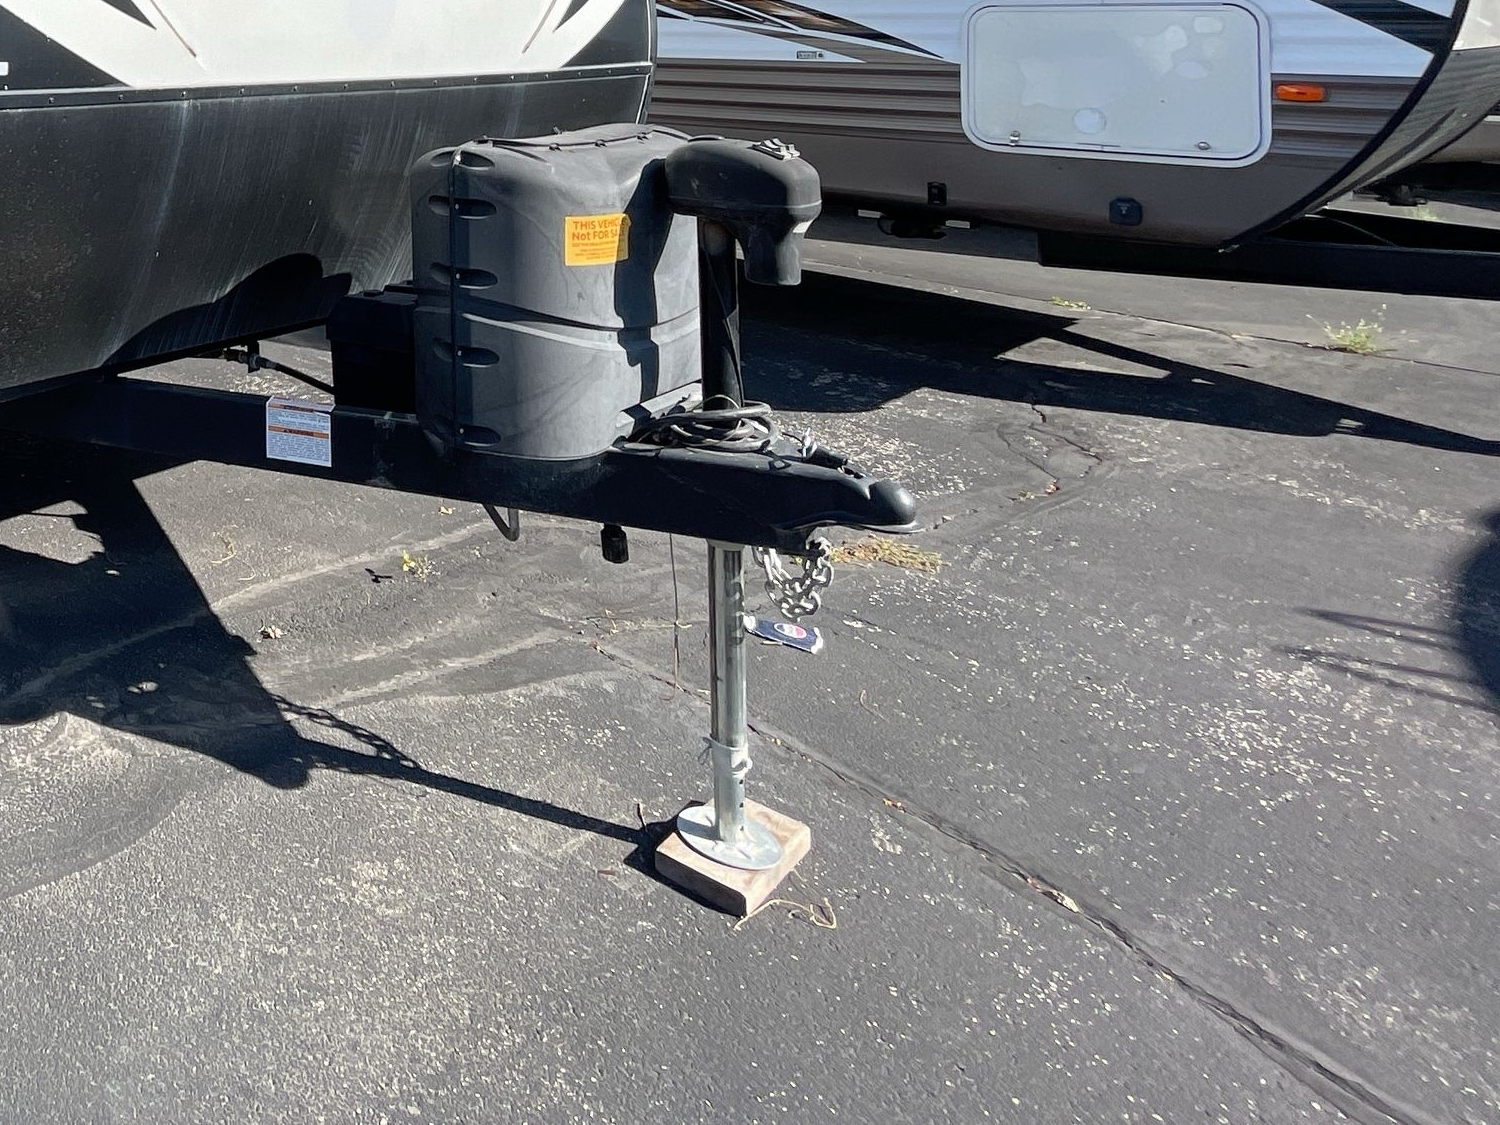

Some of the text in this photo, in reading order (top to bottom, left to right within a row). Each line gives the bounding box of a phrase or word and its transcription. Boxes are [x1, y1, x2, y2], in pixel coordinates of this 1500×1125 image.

[572, 216, 626, 231] THIS VEHICE
[572, 231, 592, 241] Not
[593, 229, 610, 240] FOR
